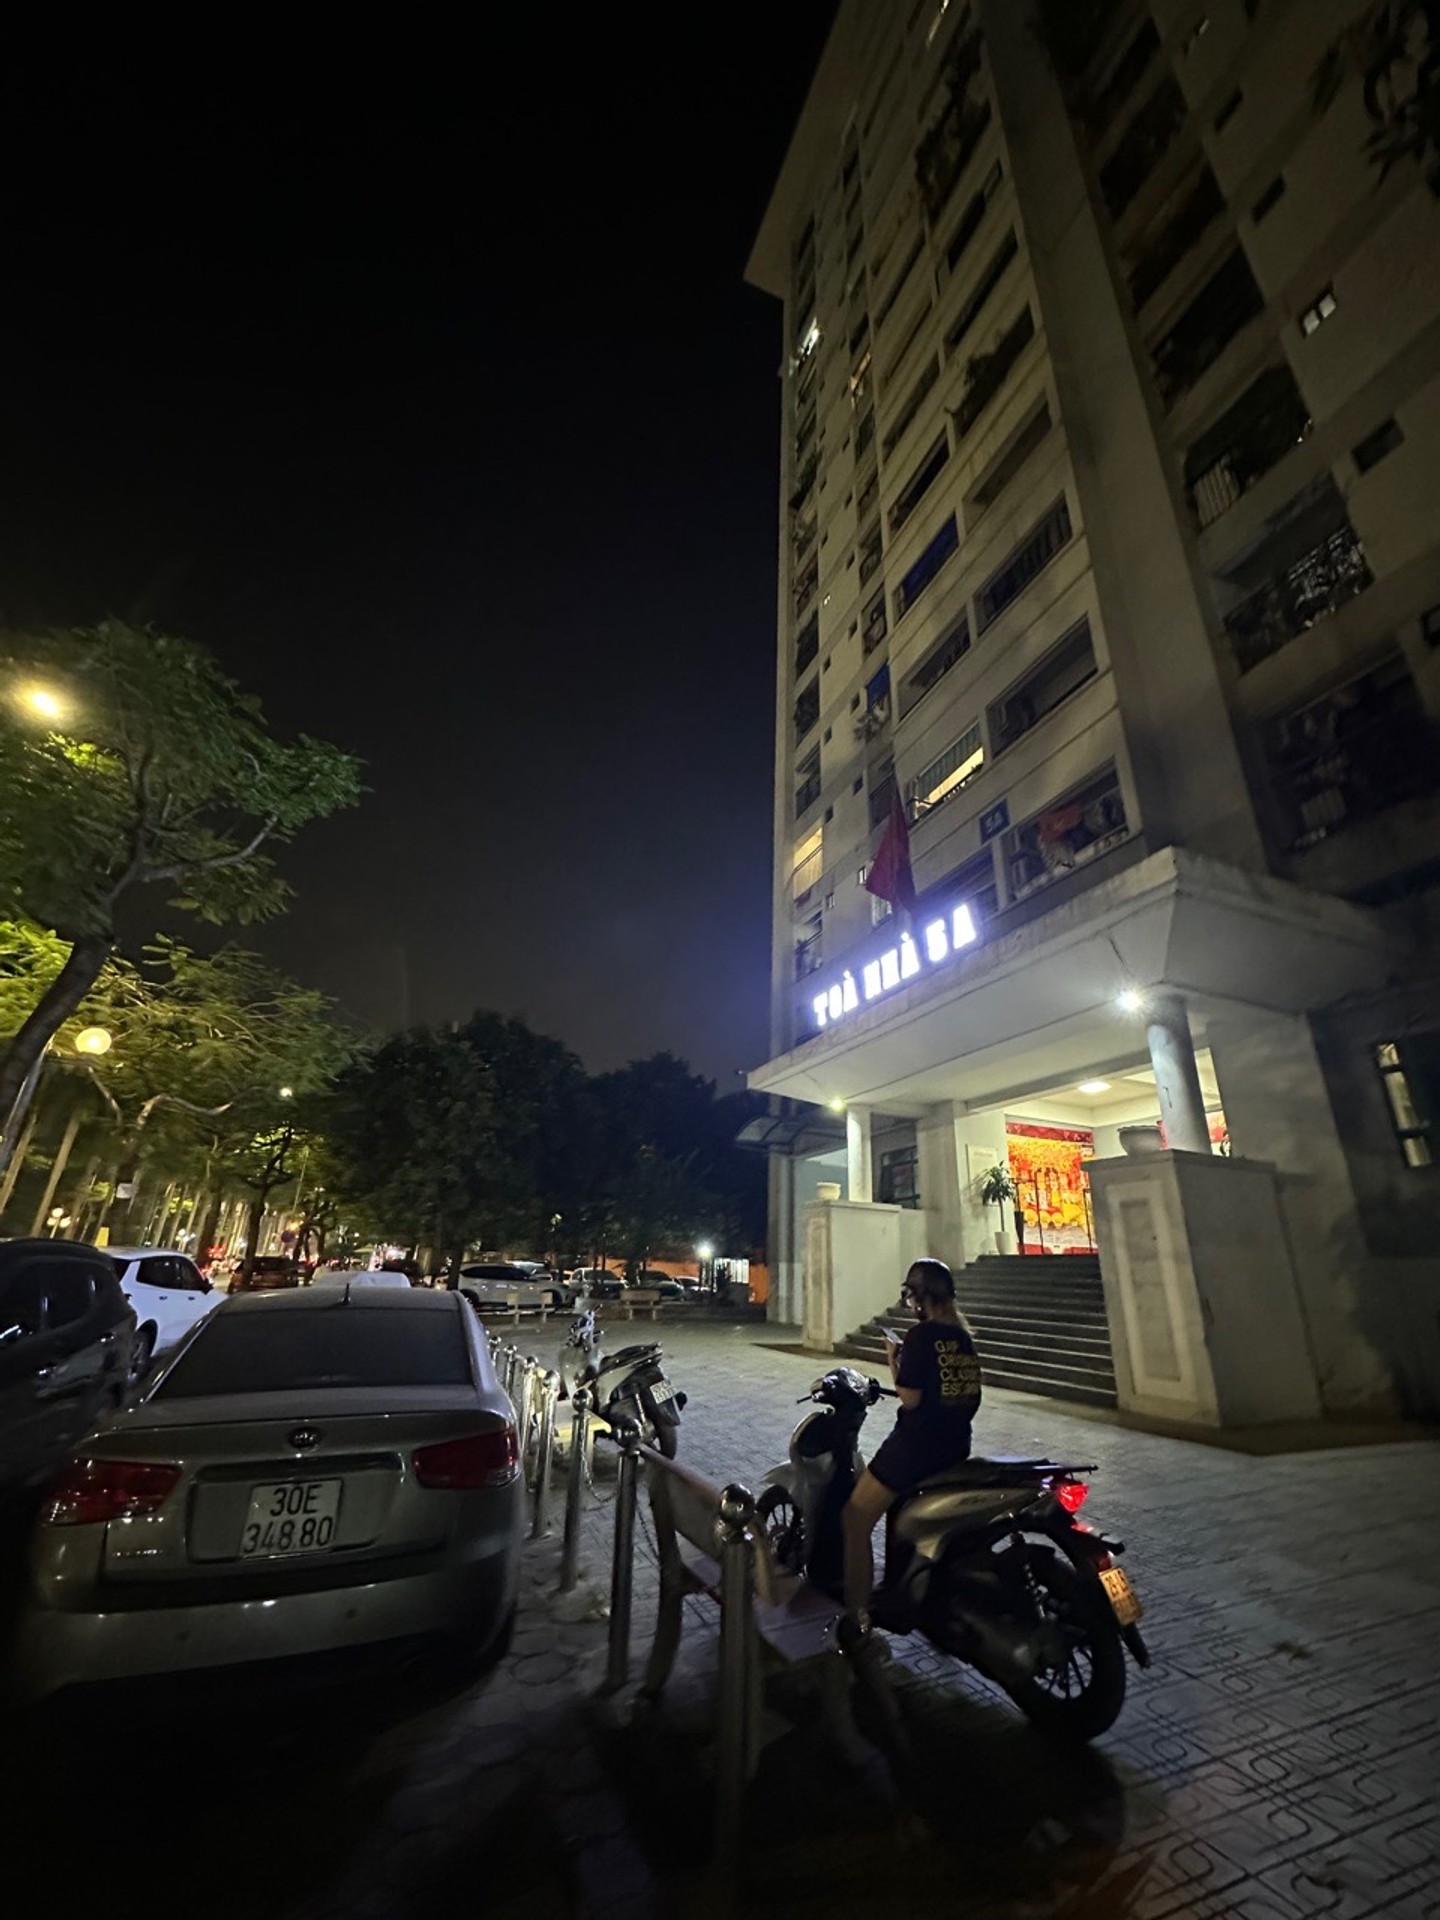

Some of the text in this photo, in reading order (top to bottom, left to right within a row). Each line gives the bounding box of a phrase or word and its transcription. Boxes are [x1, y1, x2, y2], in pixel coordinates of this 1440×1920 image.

[985, 811, 1003, 834] 5A
[813, 904, 977, 1027] TOÀ NHÀ 5A
[270, 1484, 323, 1517] 30E
